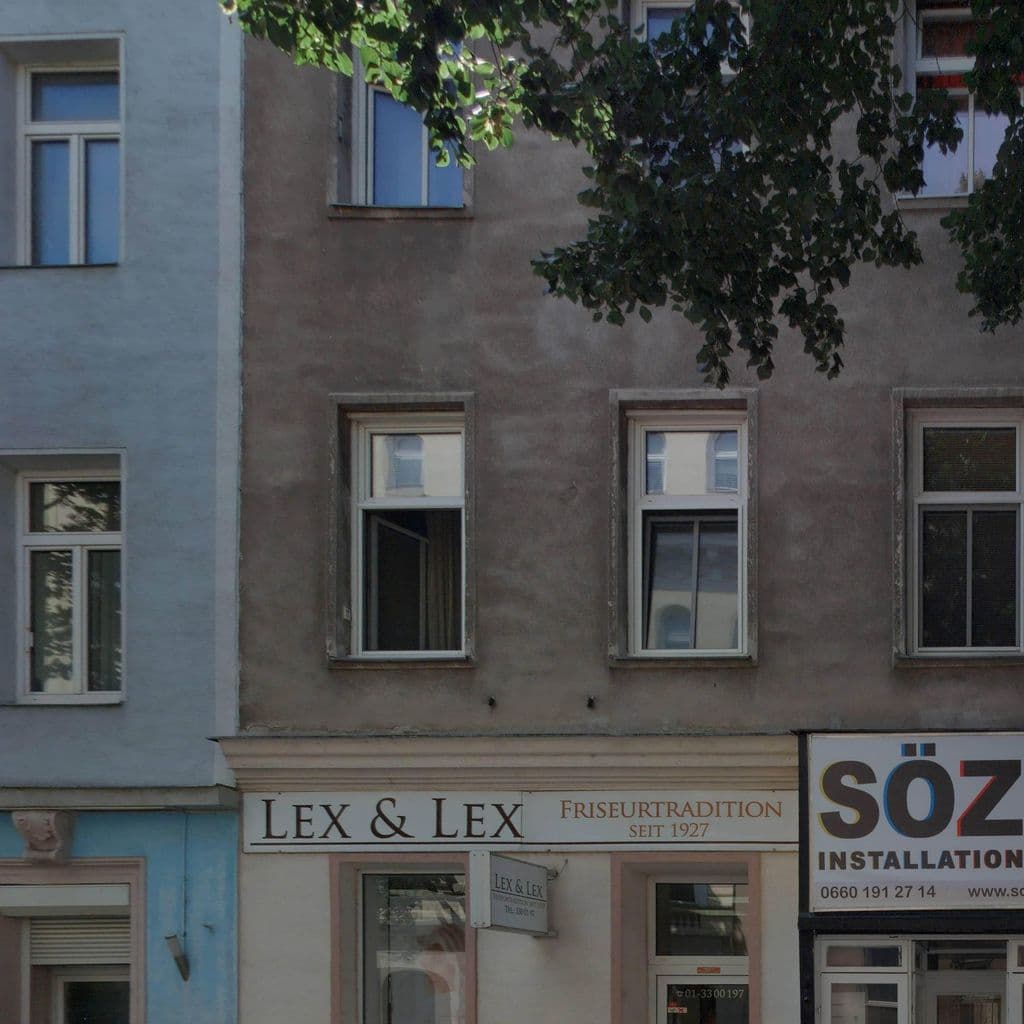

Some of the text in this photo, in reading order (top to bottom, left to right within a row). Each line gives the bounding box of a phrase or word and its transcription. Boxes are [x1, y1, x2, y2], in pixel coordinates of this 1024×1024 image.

[816, 742, 1024, 840] SÖZ
[261, 796, 525, 840] LEX & LEX
[559, 798, 785, 820] FRISEURTRADITION
[628, 822, 710, 839] SEIT 1927
[818, 849, 1024, 872] INSTALLATION
[820, 885, 858, 900] 0660
[862, 885, 889, 899] 191
[894, 885, 914, 899] 27
[917, 884, 937, 899] 14
